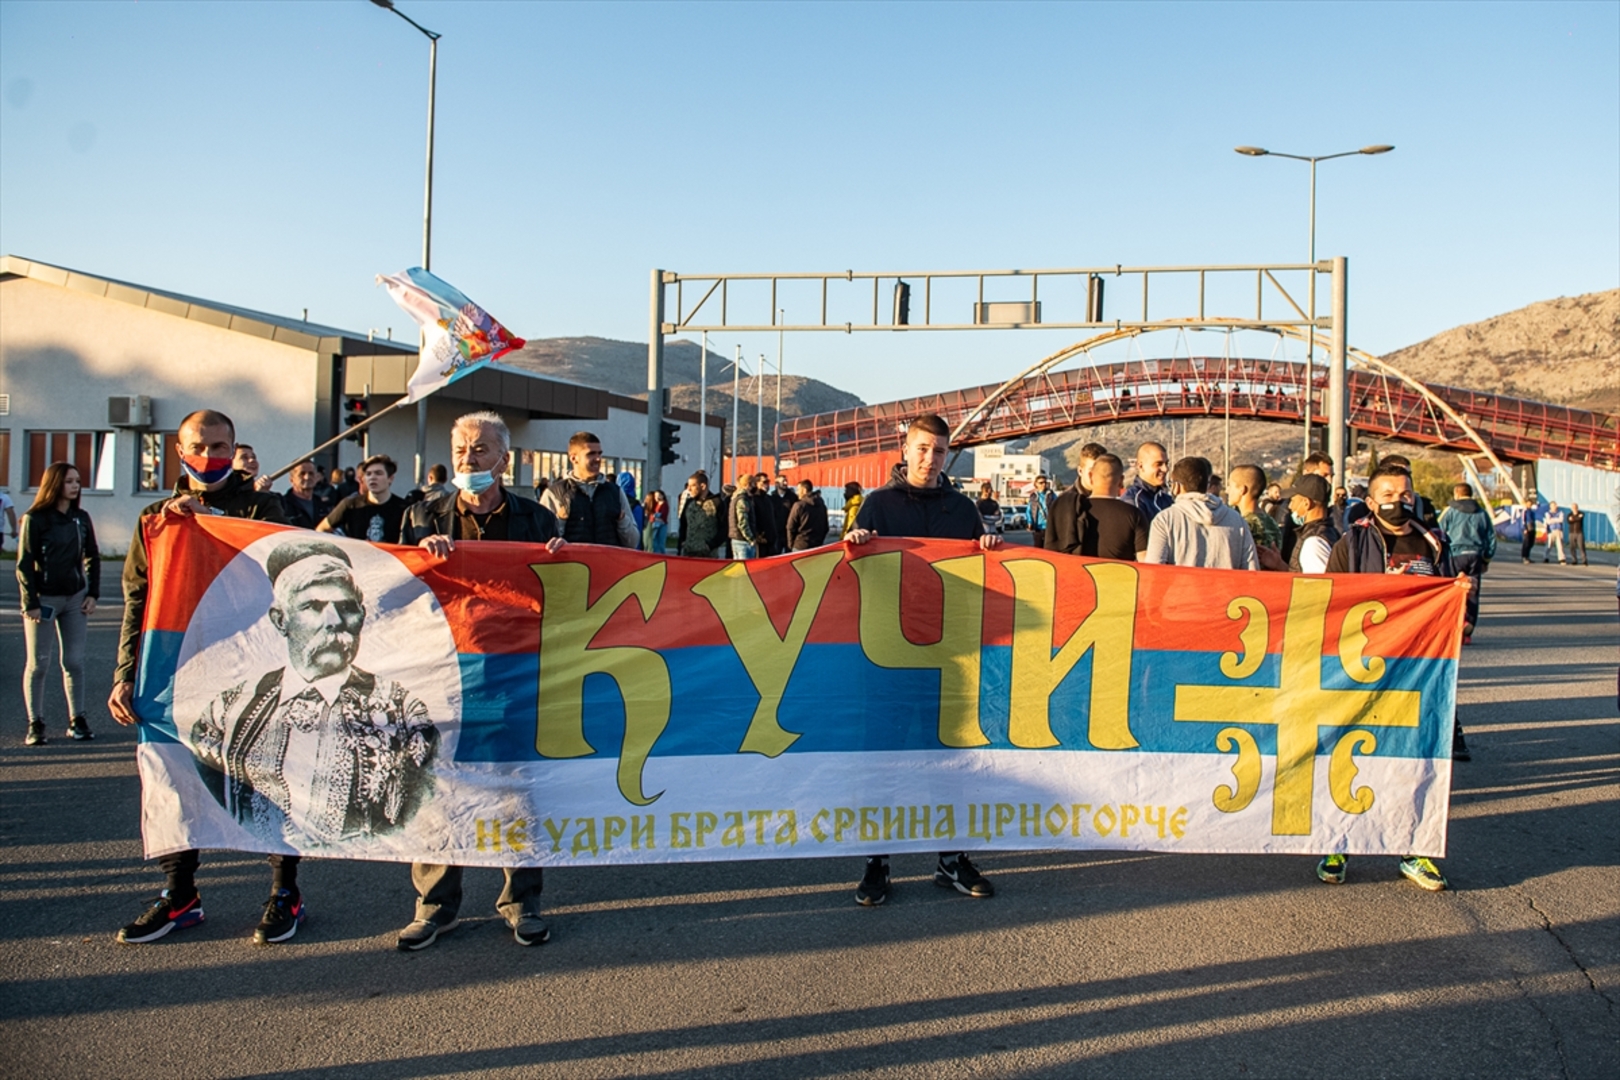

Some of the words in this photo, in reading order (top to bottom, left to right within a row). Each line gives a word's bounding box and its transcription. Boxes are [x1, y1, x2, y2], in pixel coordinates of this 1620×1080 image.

[530, 550, 1139, 805] КУЧИ
[669, 809, 798, 848] БРАТА
[810, 804, 956, 843] СРБИНА
[967, 803, 1188, 843] ЦРНОГОРЧЕ
